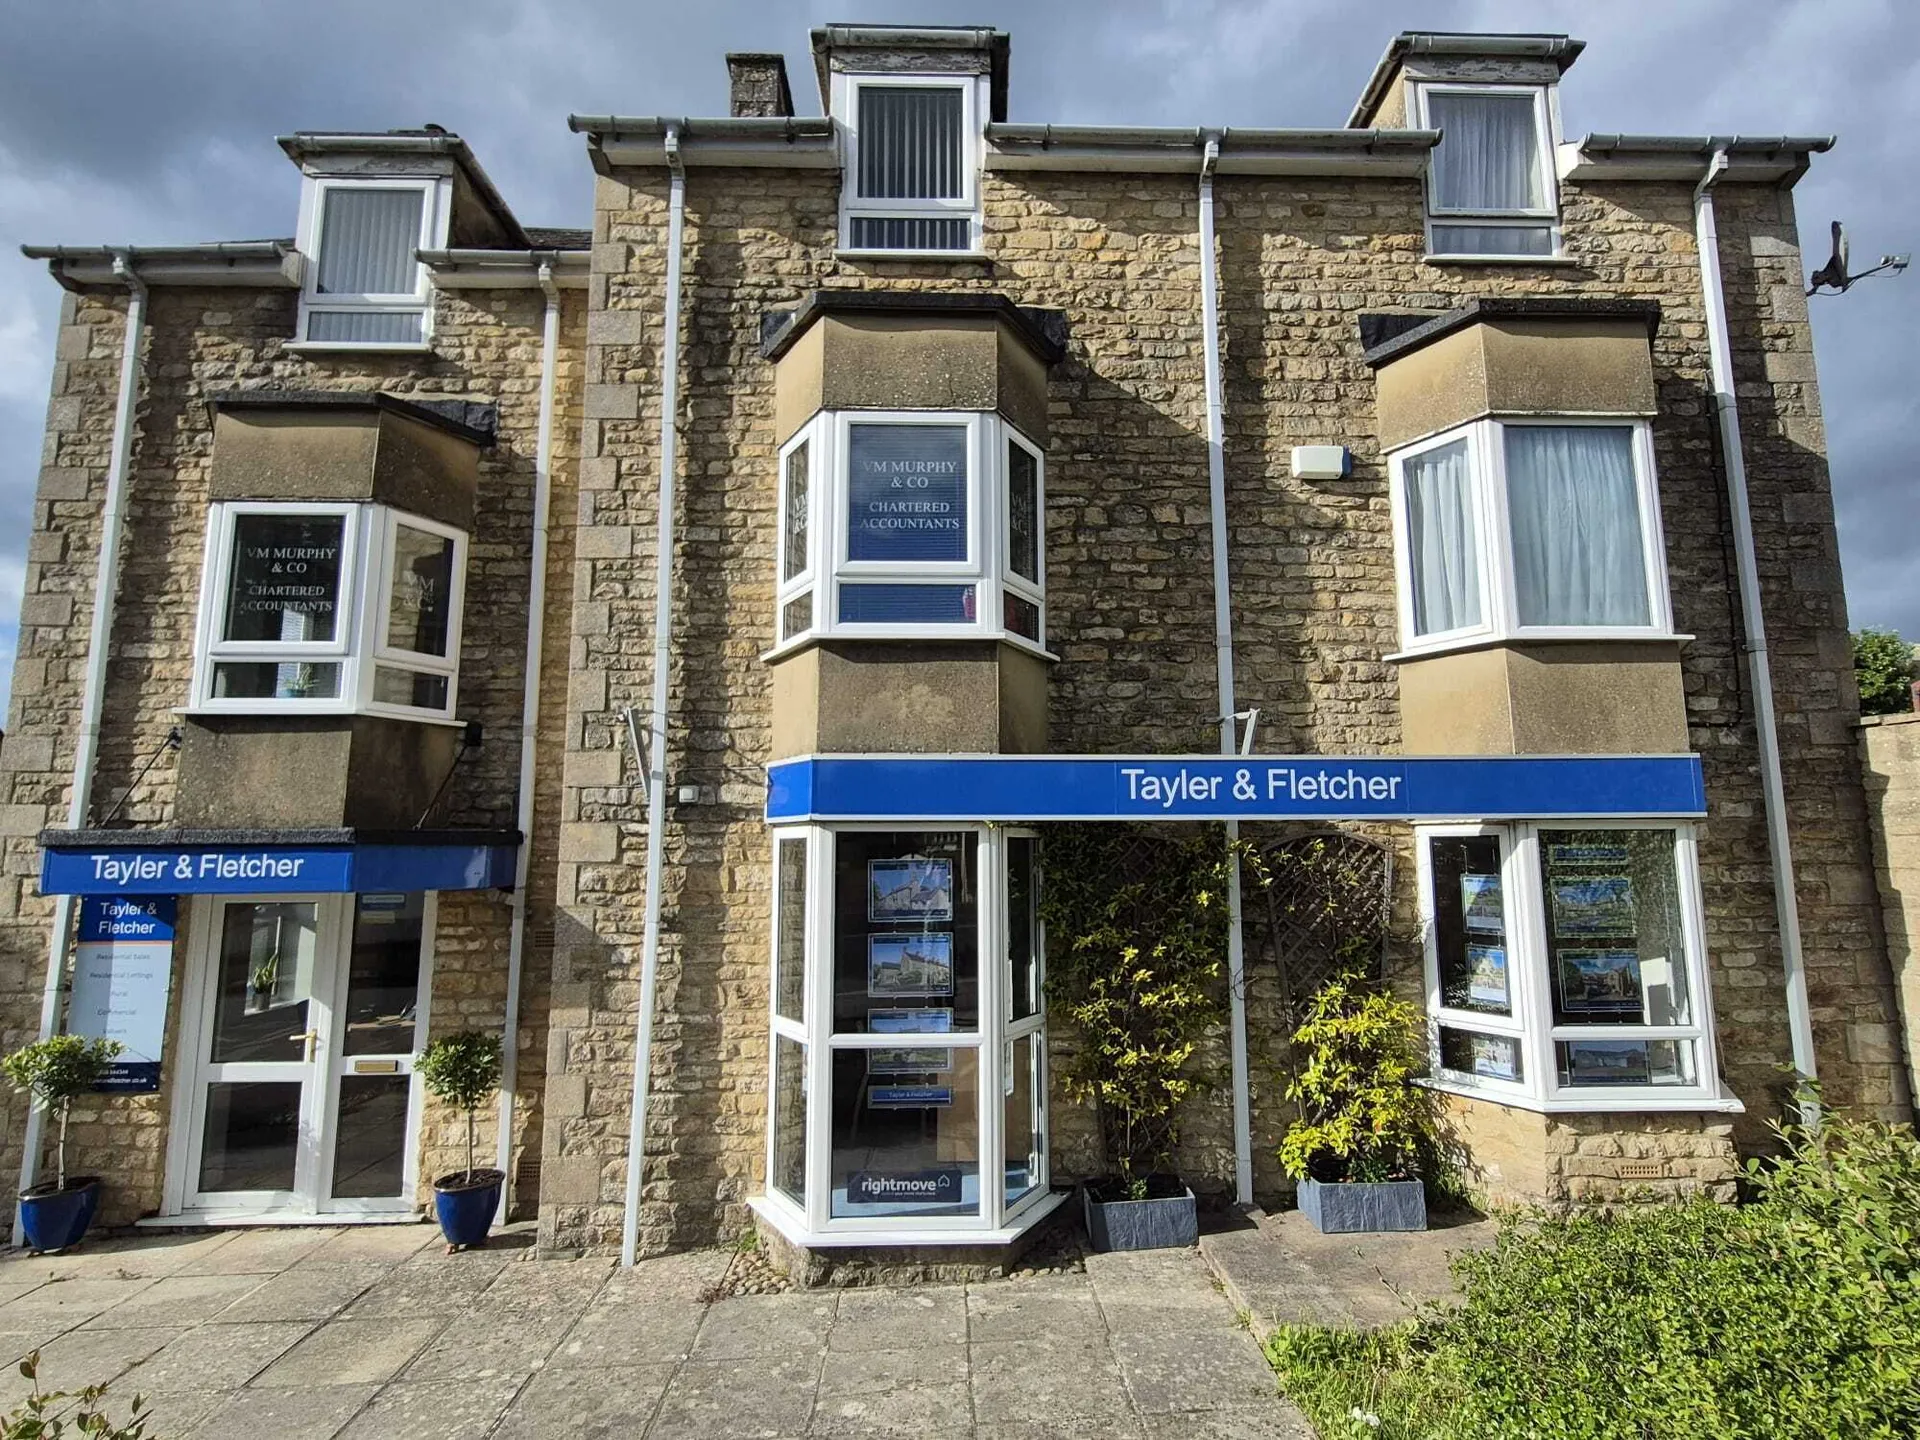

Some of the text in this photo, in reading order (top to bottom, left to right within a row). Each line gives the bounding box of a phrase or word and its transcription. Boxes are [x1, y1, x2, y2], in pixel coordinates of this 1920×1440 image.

[862, 461, 957, 473] VM MURPHY
[891, 476, 929, 488] & CO
[869, 502, 950, 513] CHARTERED
[860, 518, 960, 529] ACCOUNTANTS
[247, 547, 336, 559] VM MURPHY
[271, 562, 307, 573] & CO
[249, 586, 325, 596] CHARTERED
[241, 601, 333, 612] ACCOUNTANTS
[1121, 768, 1402, 808] Tayler & Fletcher
[91, 853, 304, 885] Tayler & Fletcher
[100, 902, 157, 919] Tayler &
[98, 920, 156, 934] Fletcher
[861, 1178, 937, 1195] rightmove
